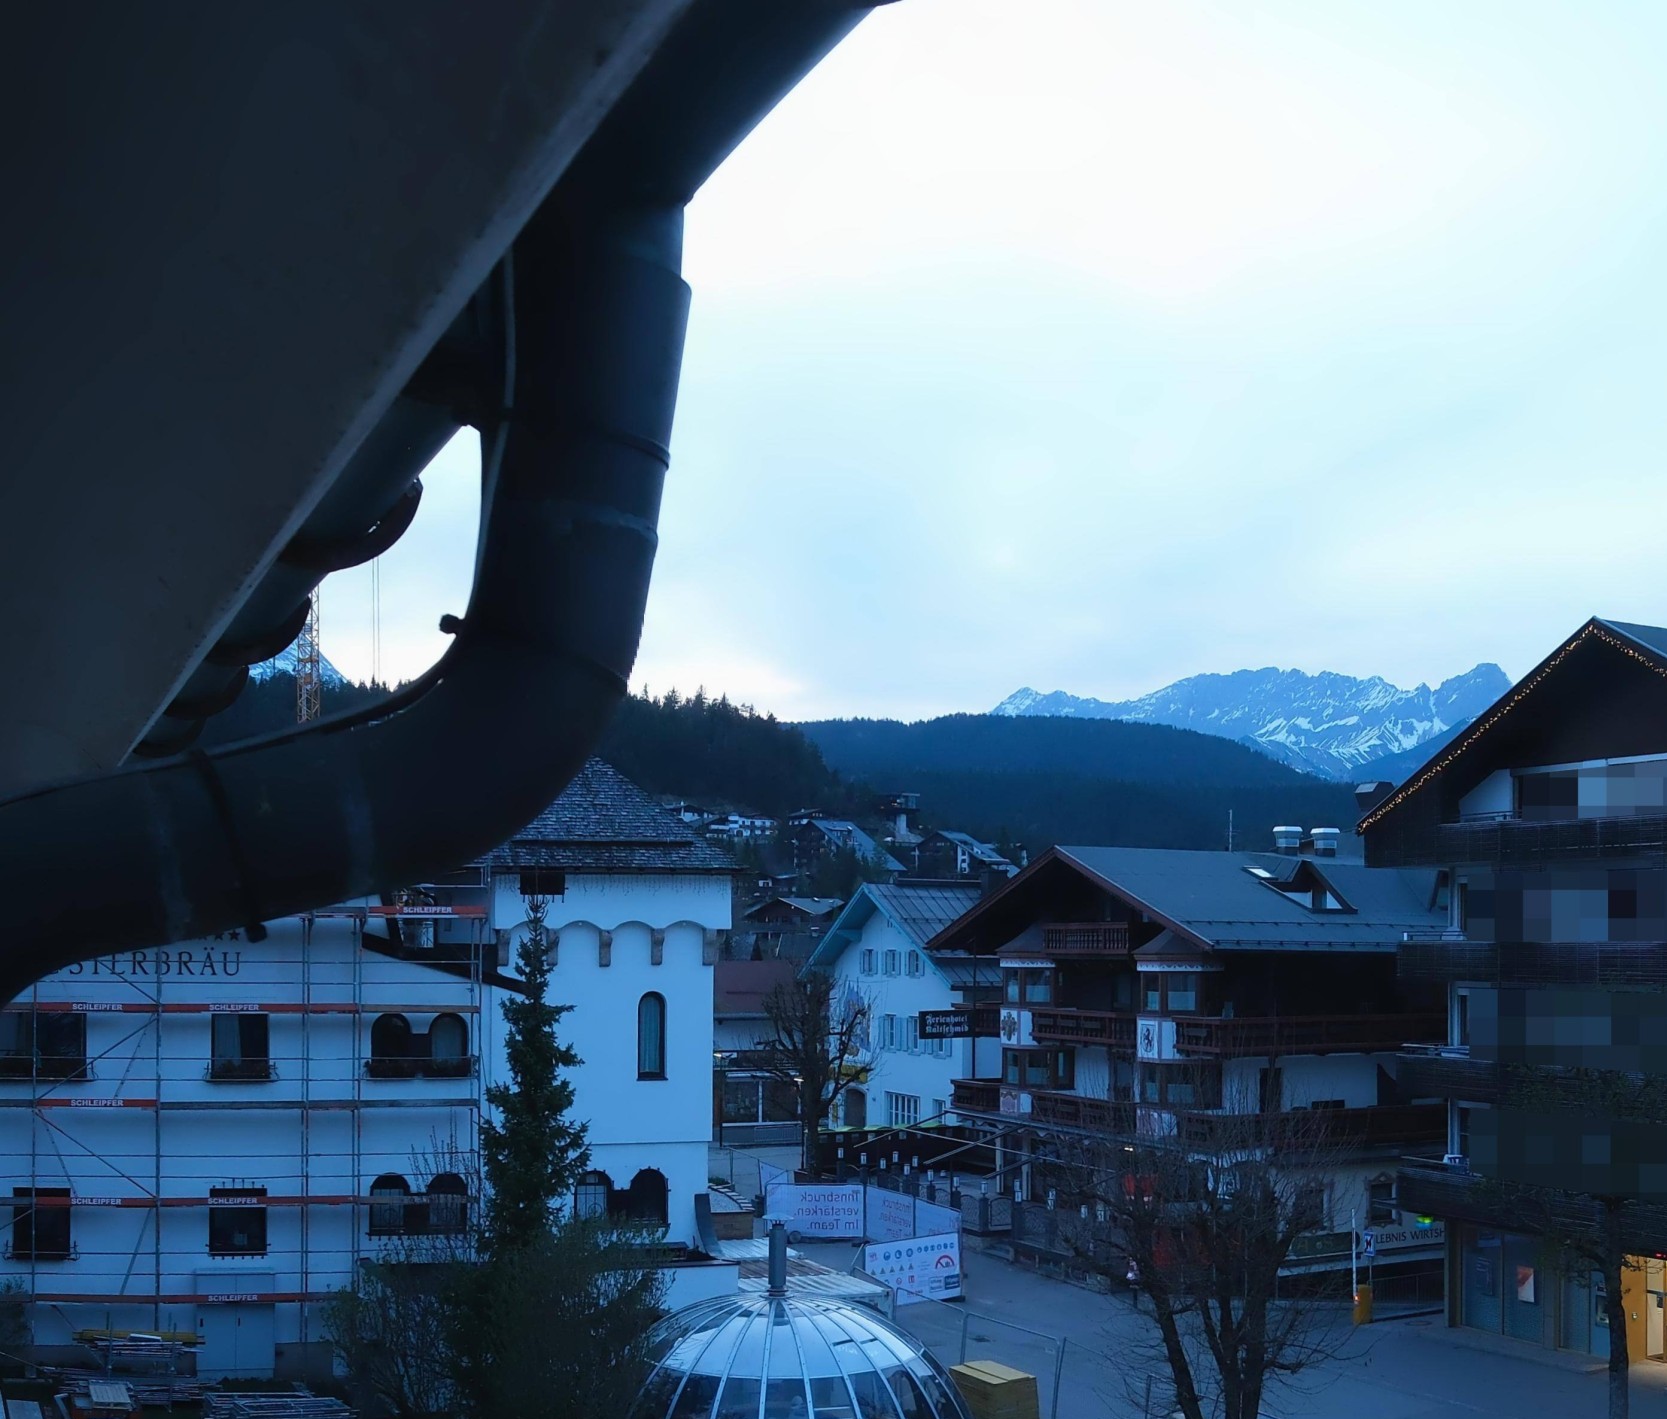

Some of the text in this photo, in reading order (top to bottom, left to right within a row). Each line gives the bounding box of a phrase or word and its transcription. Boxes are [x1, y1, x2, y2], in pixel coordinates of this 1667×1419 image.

[72, 1003, 123, 1011] SCHLEIPFER
[209, 1003, 259, 1011] SCHLEIPFER
[71, 1099, 124, 1107] SCHLEIPFER
[208, 1197, 258, 1205] SCHLEIPFER
[208, 1294, 258, 1302] SCHLEIPFER
